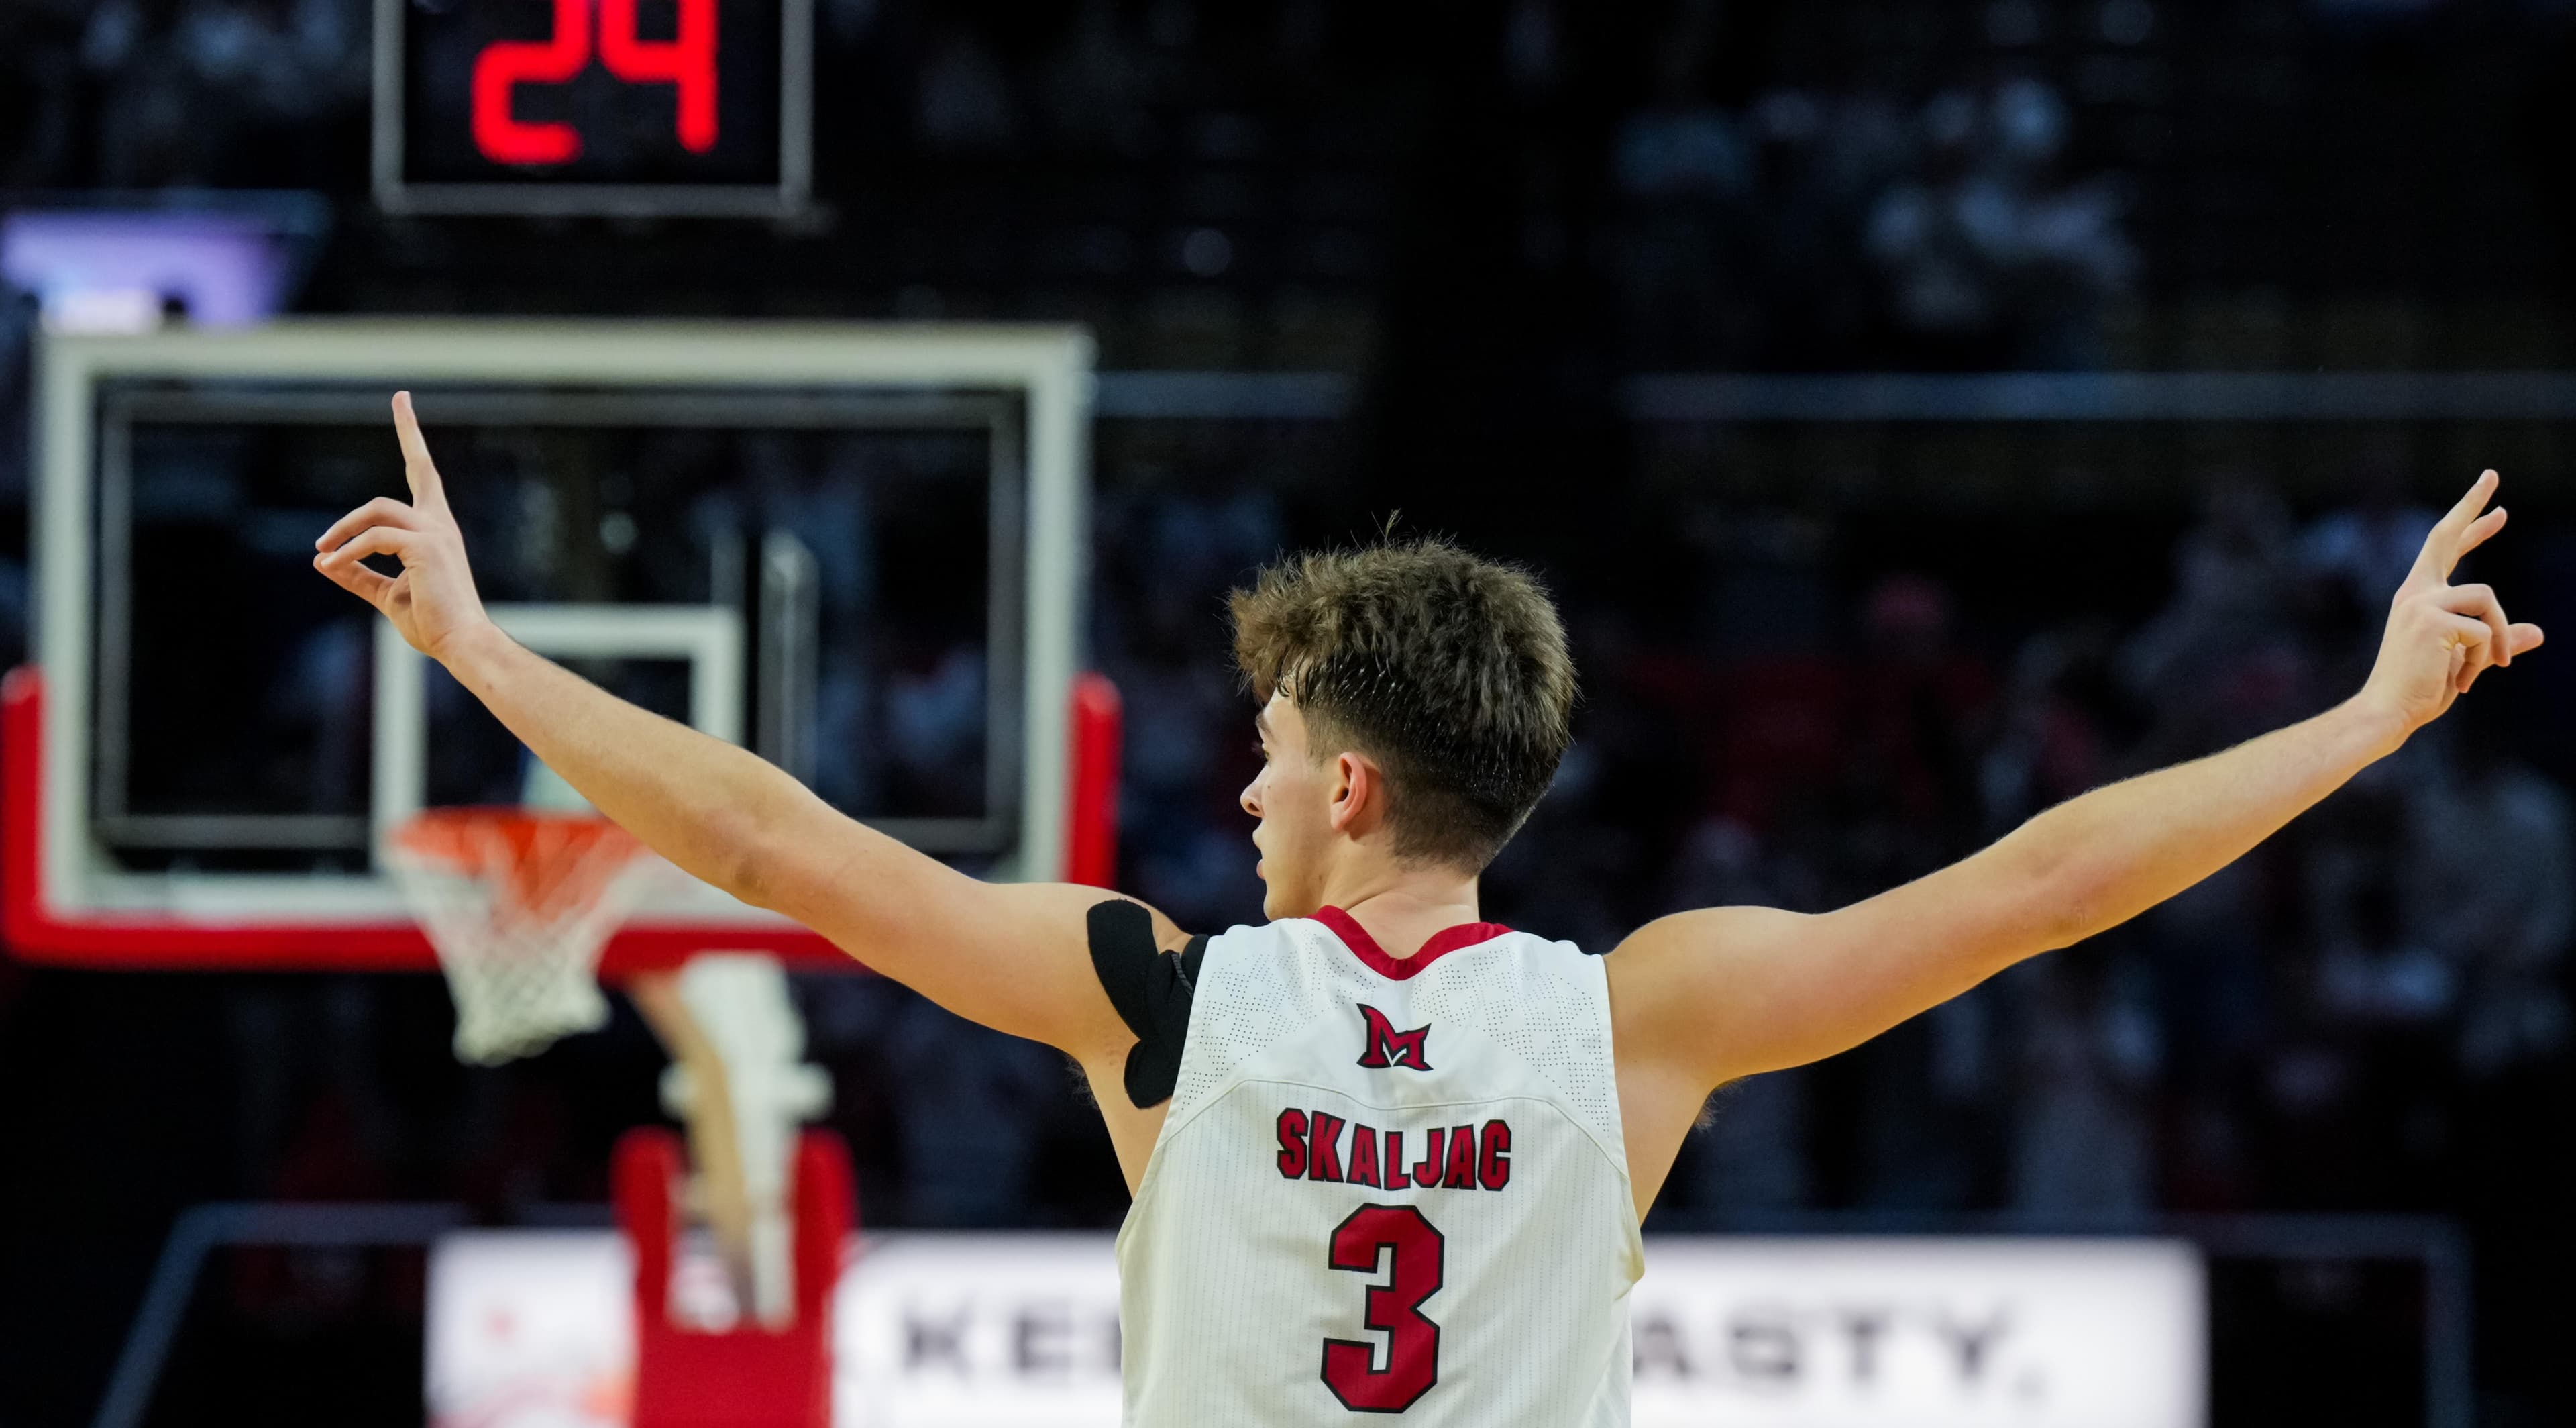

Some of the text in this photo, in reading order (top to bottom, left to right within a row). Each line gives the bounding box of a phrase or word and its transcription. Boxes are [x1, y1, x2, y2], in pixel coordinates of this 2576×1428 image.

[472, 0, 719, 165] 24
[1356, 1003, 1434, 1071] M
[1277, 1107, 1511, 1191] SKALJAC
[902, 1298, 1122, 1381] KE
[1320, 1203, 1445, 1414] 3
